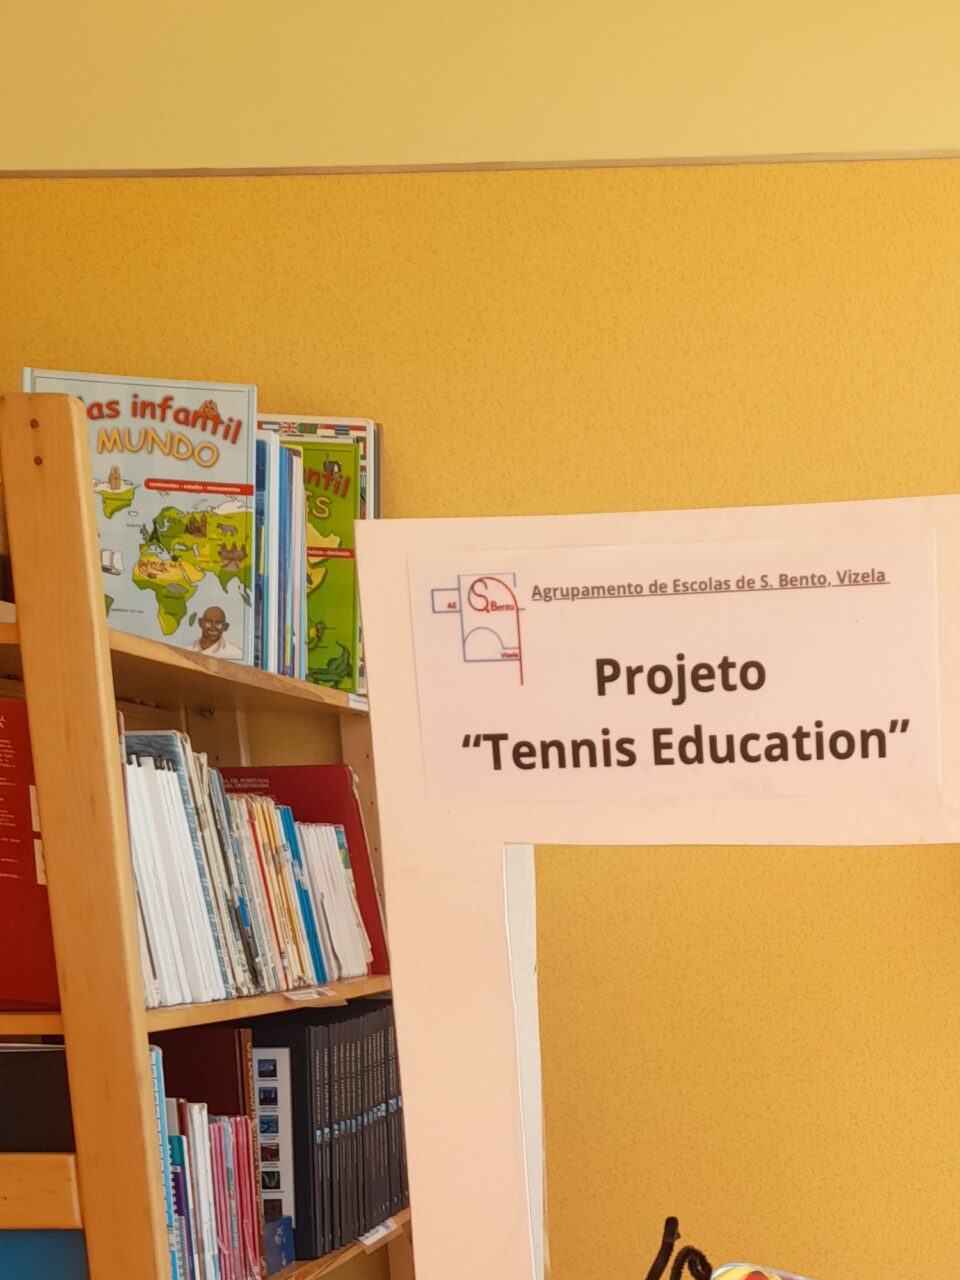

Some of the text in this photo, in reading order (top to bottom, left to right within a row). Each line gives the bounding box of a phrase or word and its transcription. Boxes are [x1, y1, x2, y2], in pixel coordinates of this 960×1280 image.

[131, 393, 242, 445] infantil
[97, 426, 219, 468] MUNDO
[532, 568, 886, 602] Agrupamento de Escolas de S. Bento, Vizela
[595, 653, 766, 705] Projeto
[462, 719, 910, 770] “Tennis Education”
